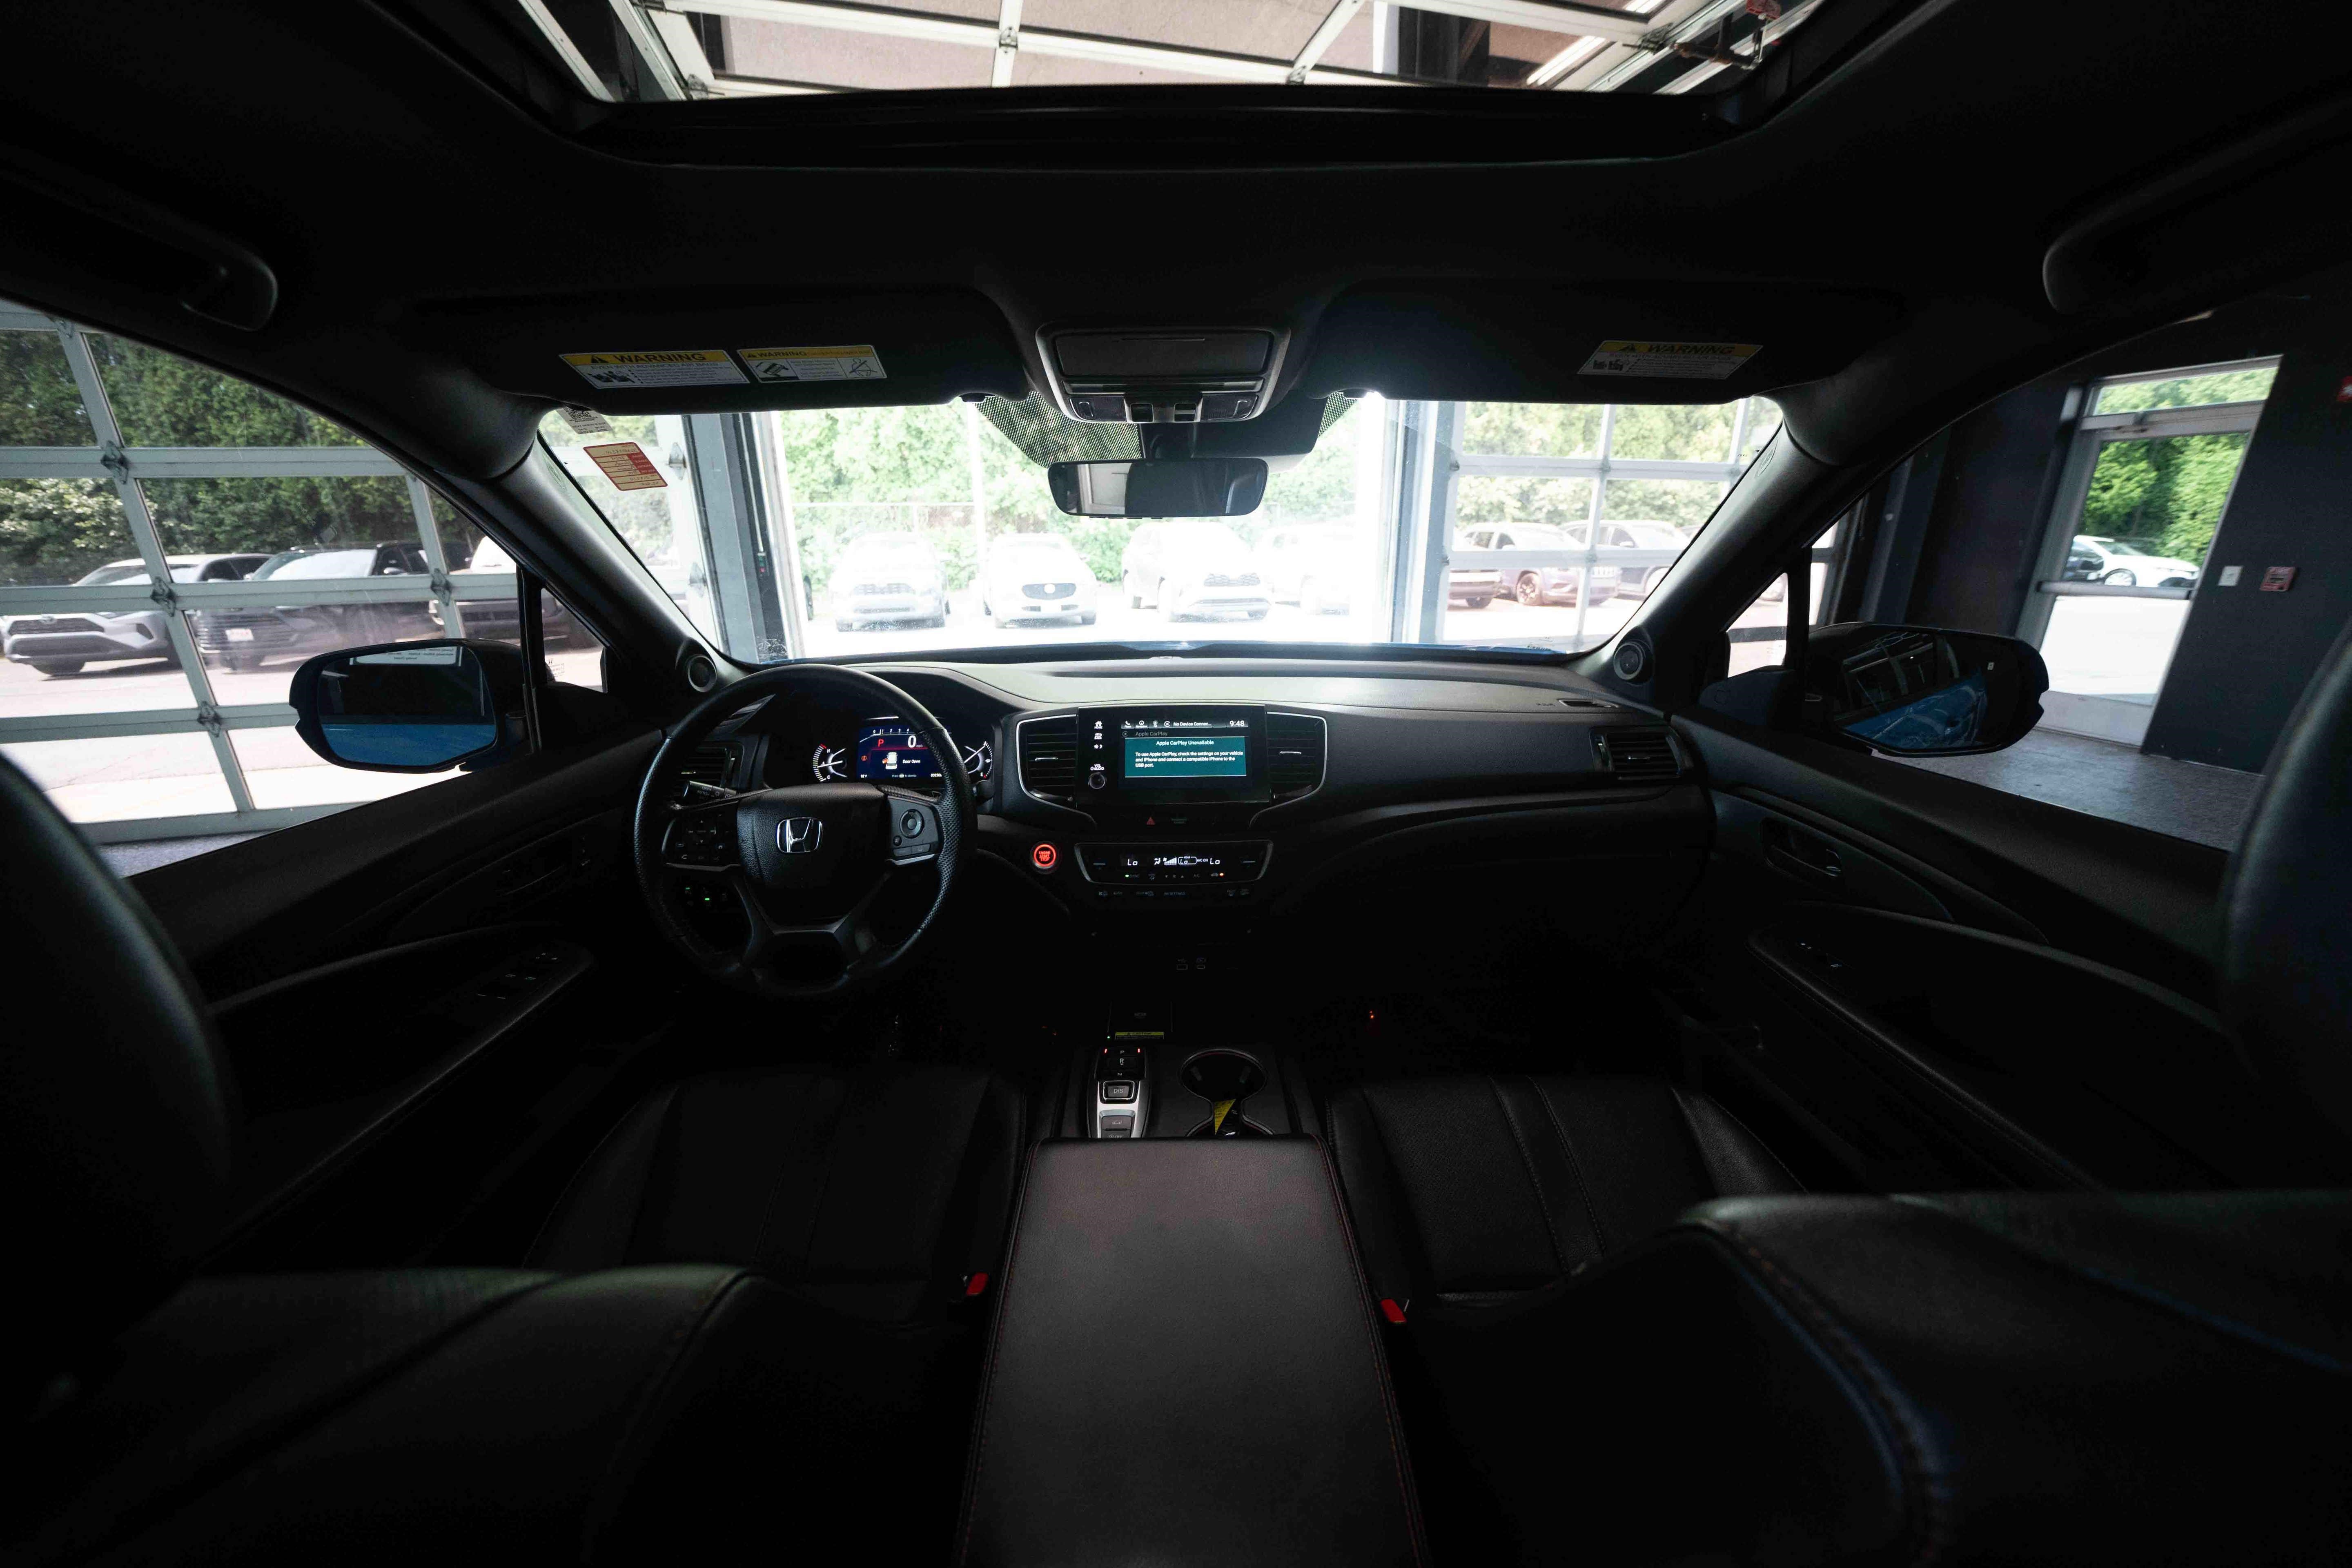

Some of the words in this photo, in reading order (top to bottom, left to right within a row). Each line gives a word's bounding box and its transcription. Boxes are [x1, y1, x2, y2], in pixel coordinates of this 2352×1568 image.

[1648, 345, 1735, 354] WARNING
[613, 353, 706, 363] WARNING
[878, 739, 884, 747] P
[908, 735, 916, 748] 0
